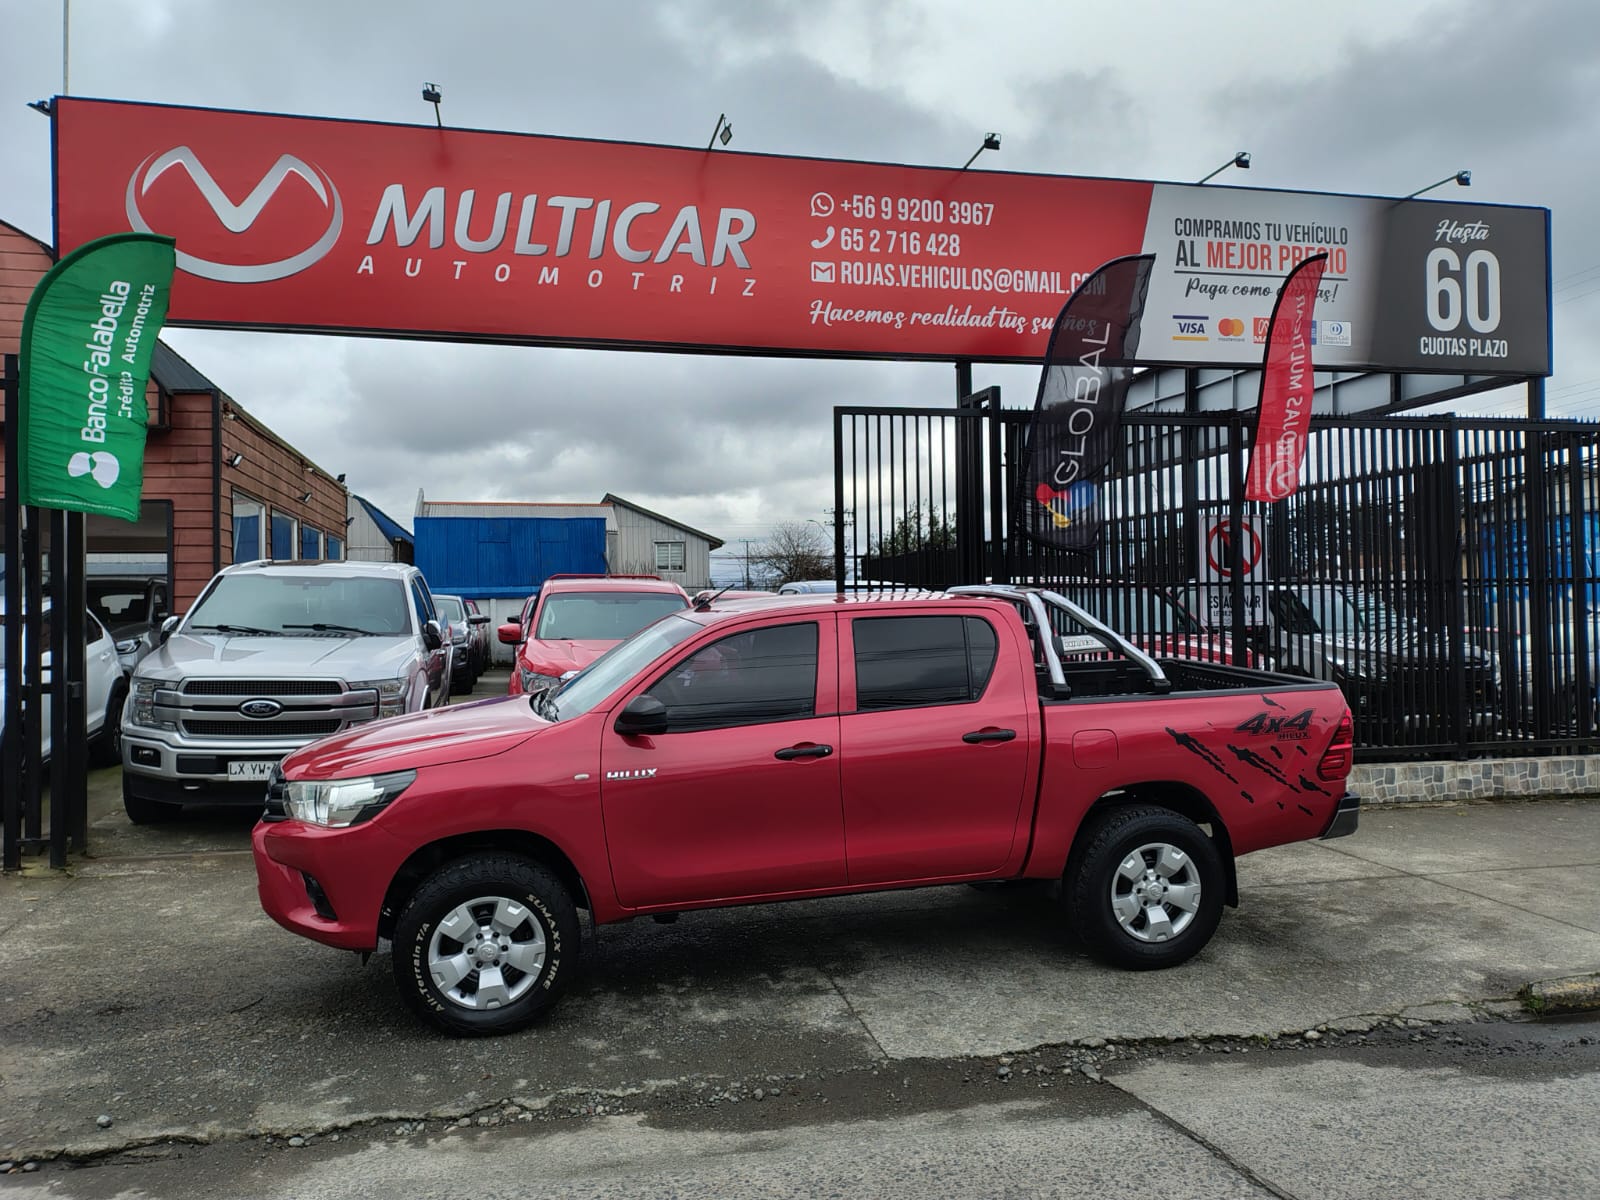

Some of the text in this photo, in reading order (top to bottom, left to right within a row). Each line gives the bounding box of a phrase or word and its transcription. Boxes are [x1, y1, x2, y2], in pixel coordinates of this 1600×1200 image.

[366, 184, 757, 268] MULTICAR
[841, 195, 994, 226] +56 9 9200 3967
[840, 227, 960, 256] 65 2 716 428
[1174, 218, 1349, 245] COMPRAMOS TU VEHÍCULO
[1435, 219, 1490, 244] Hasta
[1175, 239, 1201, 268] AL
[1207, 241, 1272, 271] MEJOR
[356, 255, 757, 297] AUTOMOTRIZ
[1185, 277, 1229, 300] Paga
[1232, 285, 1272, 296] como
[1426, 247, 1501, 334] 60
[122, 284, 156, 364] Automotriz
[810, 300, 1098, 335] Hacemos realidad tus suños
[1178, 322, 1205, 334] VISA
[1420, 336, 1509, 359] CUOTAS PLAZO
[1054, 322, 1111, 485] GLOBAL
[1278, 732, 1310, 741] HILUX
[416, 922, 431, 942] T/A
[543, 959, 561, 990] TIRE
